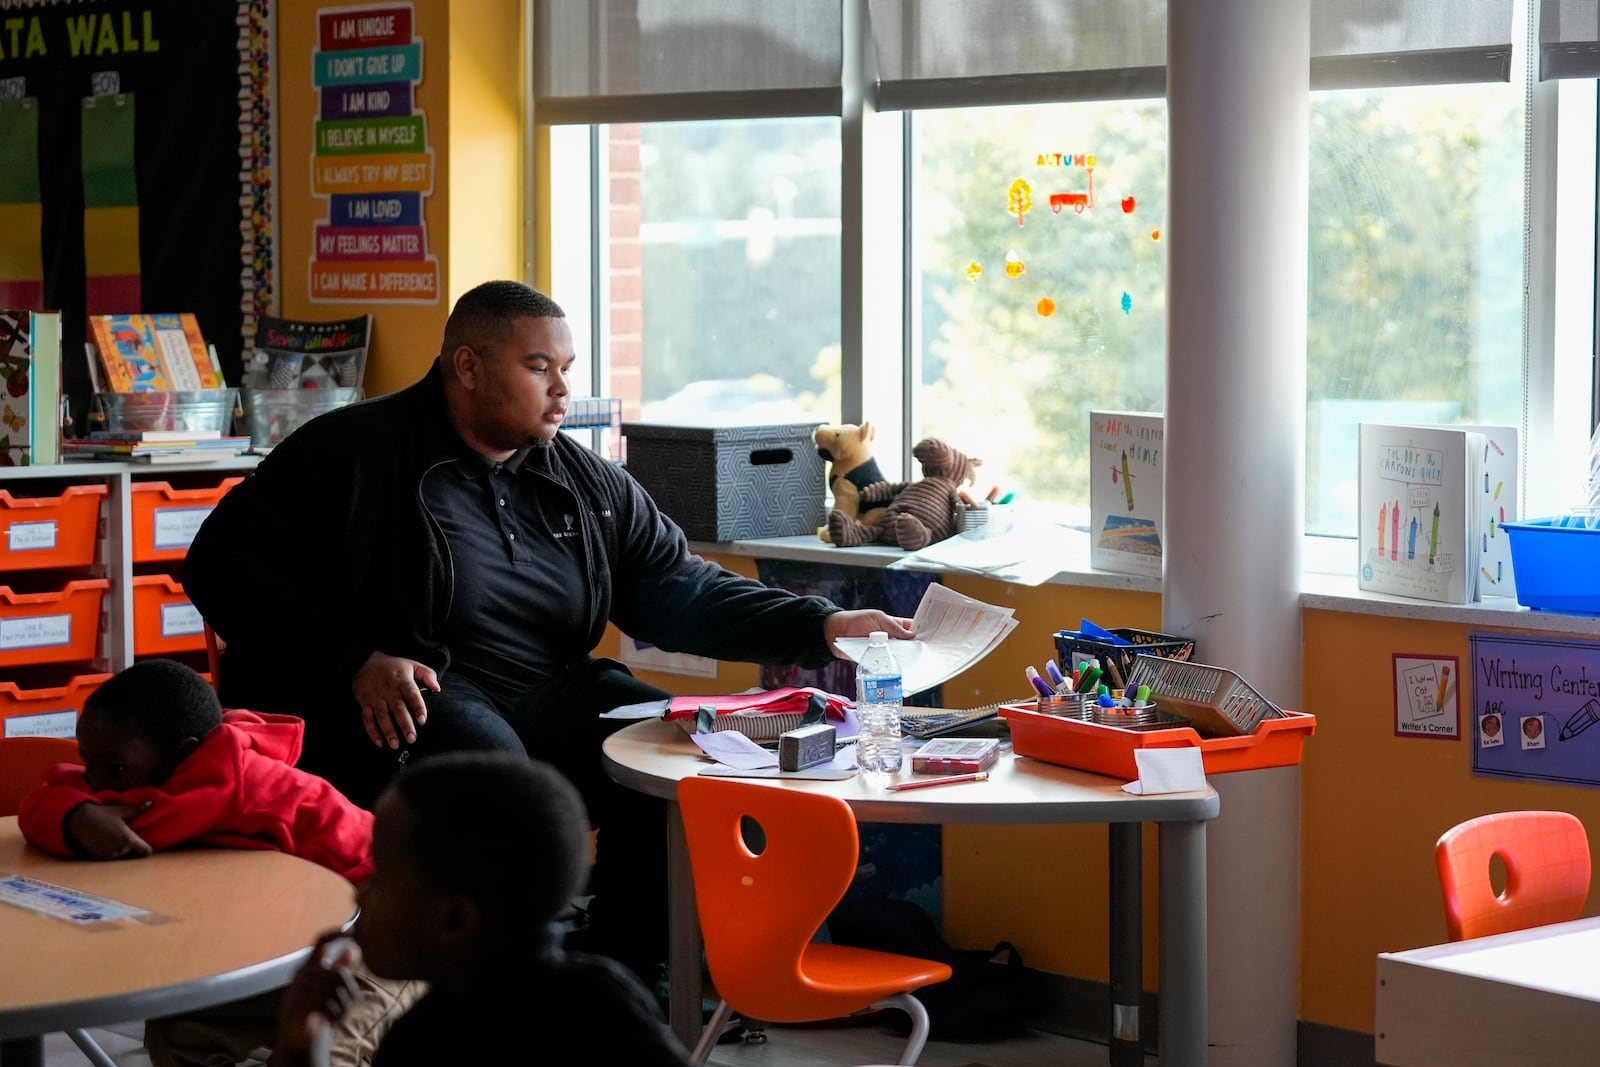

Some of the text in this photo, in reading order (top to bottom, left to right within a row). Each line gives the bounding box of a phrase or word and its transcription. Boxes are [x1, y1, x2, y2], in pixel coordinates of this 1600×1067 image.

[66, 10, 160, 57] WALL
[333, 15, 395, 39] I AM UNIQUE
[328, 54, 405, 77] I DON'T GIVE UP
[342, 90, 390, 112] I AM KIND
[321, 125, 417, 147] I BELIEVE IN MYSELF
[316, 162, 426, 184] I ALWAYS TRY MY BEST
[348, 199, 402, 219] I AM LOVED
[320, 234, 419, 254] MY FEELINGS MATTER
[314, 272, 435, 291] I CAN MAKE A DIFFERENCE
[1136, 426, 1163, 441] CRAYON
[1129, 441, 1158, 466] HOME
[1404, 449, 1421, 465] DAY
[1380, 458, 1416, 478] CRAYONS
[1480, 657, 1543, 700] Writing
[1485, 700, 1506, 716] ABC
[1402, 722, 1453, 733] Writer's Corner
